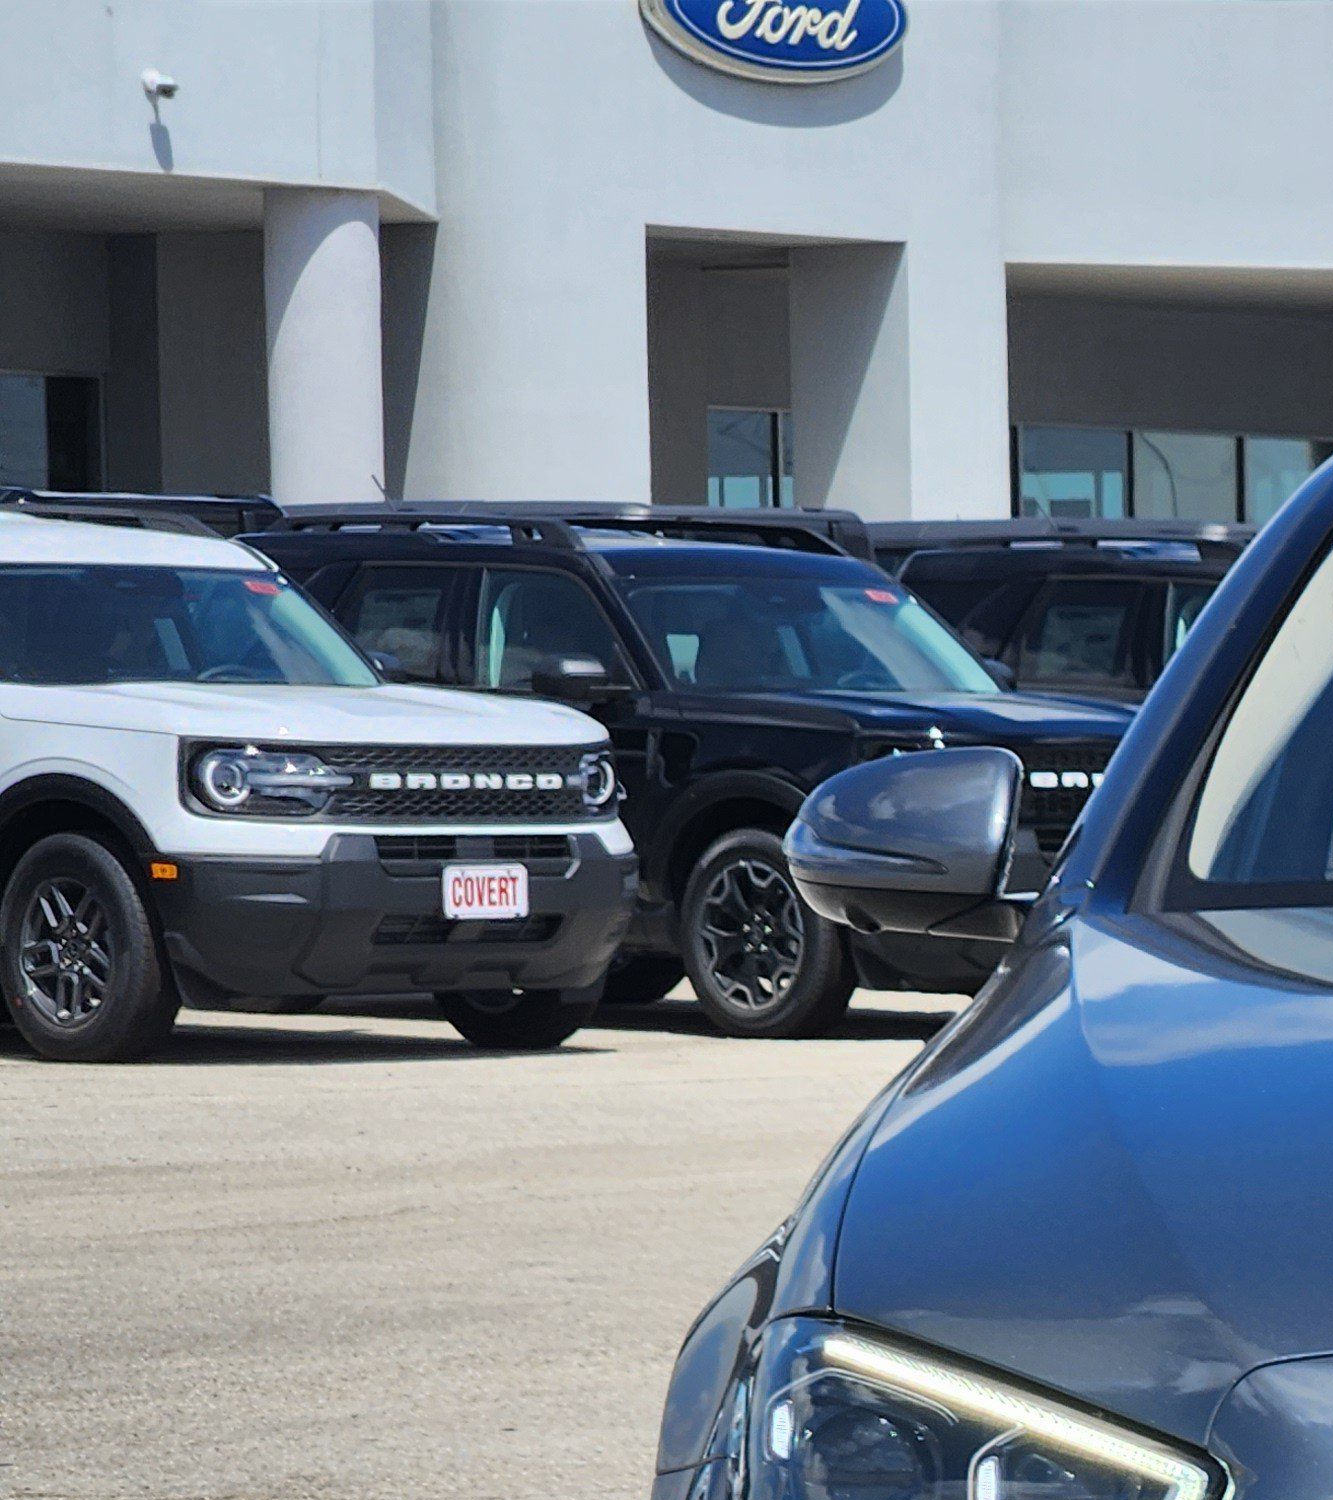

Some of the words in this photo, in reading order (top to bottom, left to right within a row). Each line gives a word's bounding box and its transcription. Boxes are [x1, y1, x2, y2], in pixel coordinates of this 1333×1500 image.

[716, 0, 858, 50] Ford
[369, 772, 563, 790] BRONCO
[452, 876, 519, 907] COVERT
